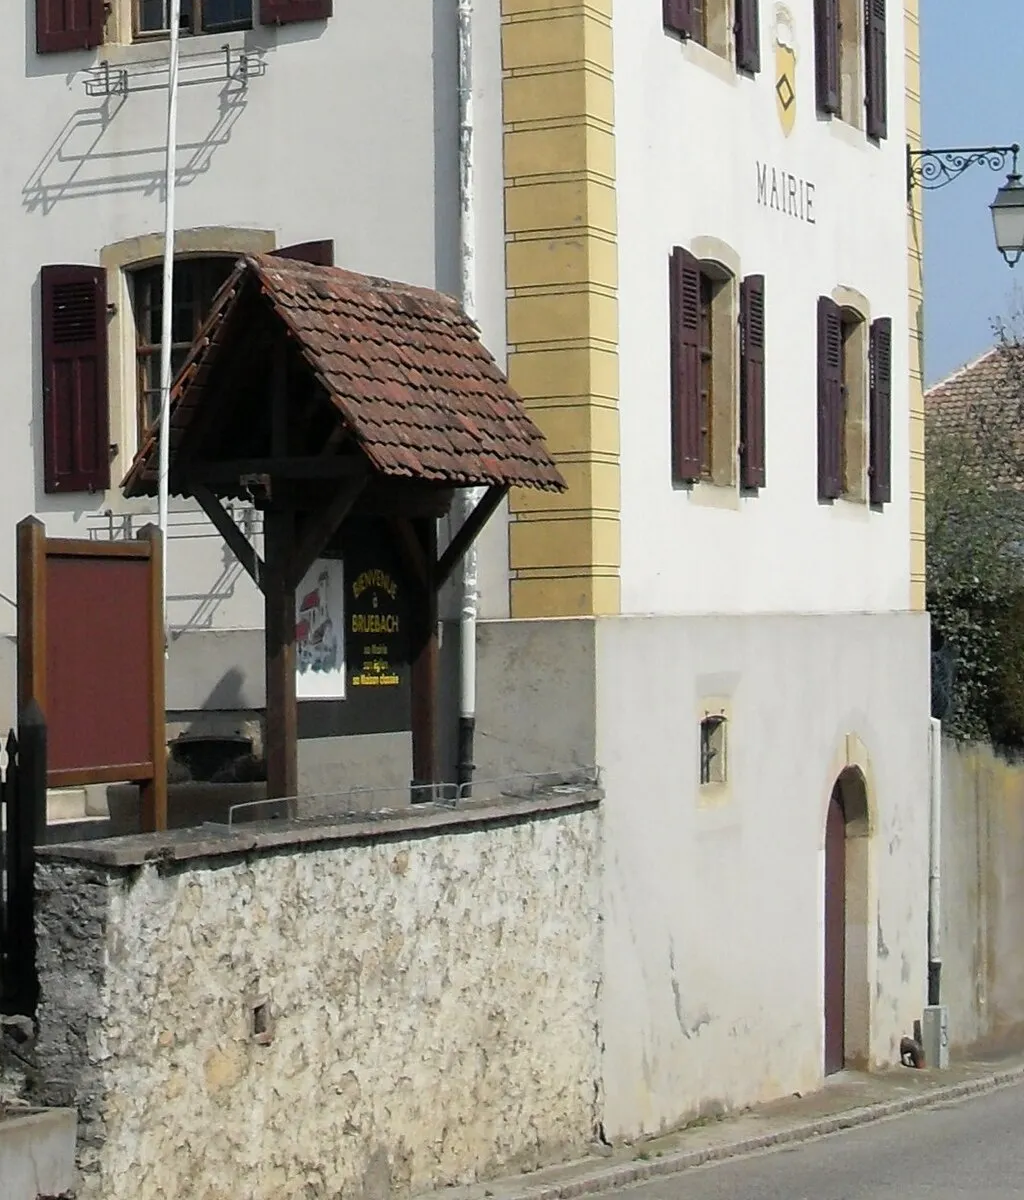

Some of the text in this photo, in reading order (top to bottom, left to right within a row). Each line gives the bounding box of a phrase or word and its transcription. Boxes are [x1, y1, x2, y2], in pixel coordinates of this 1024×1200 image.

[756, 160, 816, 225] MAIRIE
[352, 568, 398, 600] BIENVENUE
[352, 614, 400, 633] BRUEBACH
